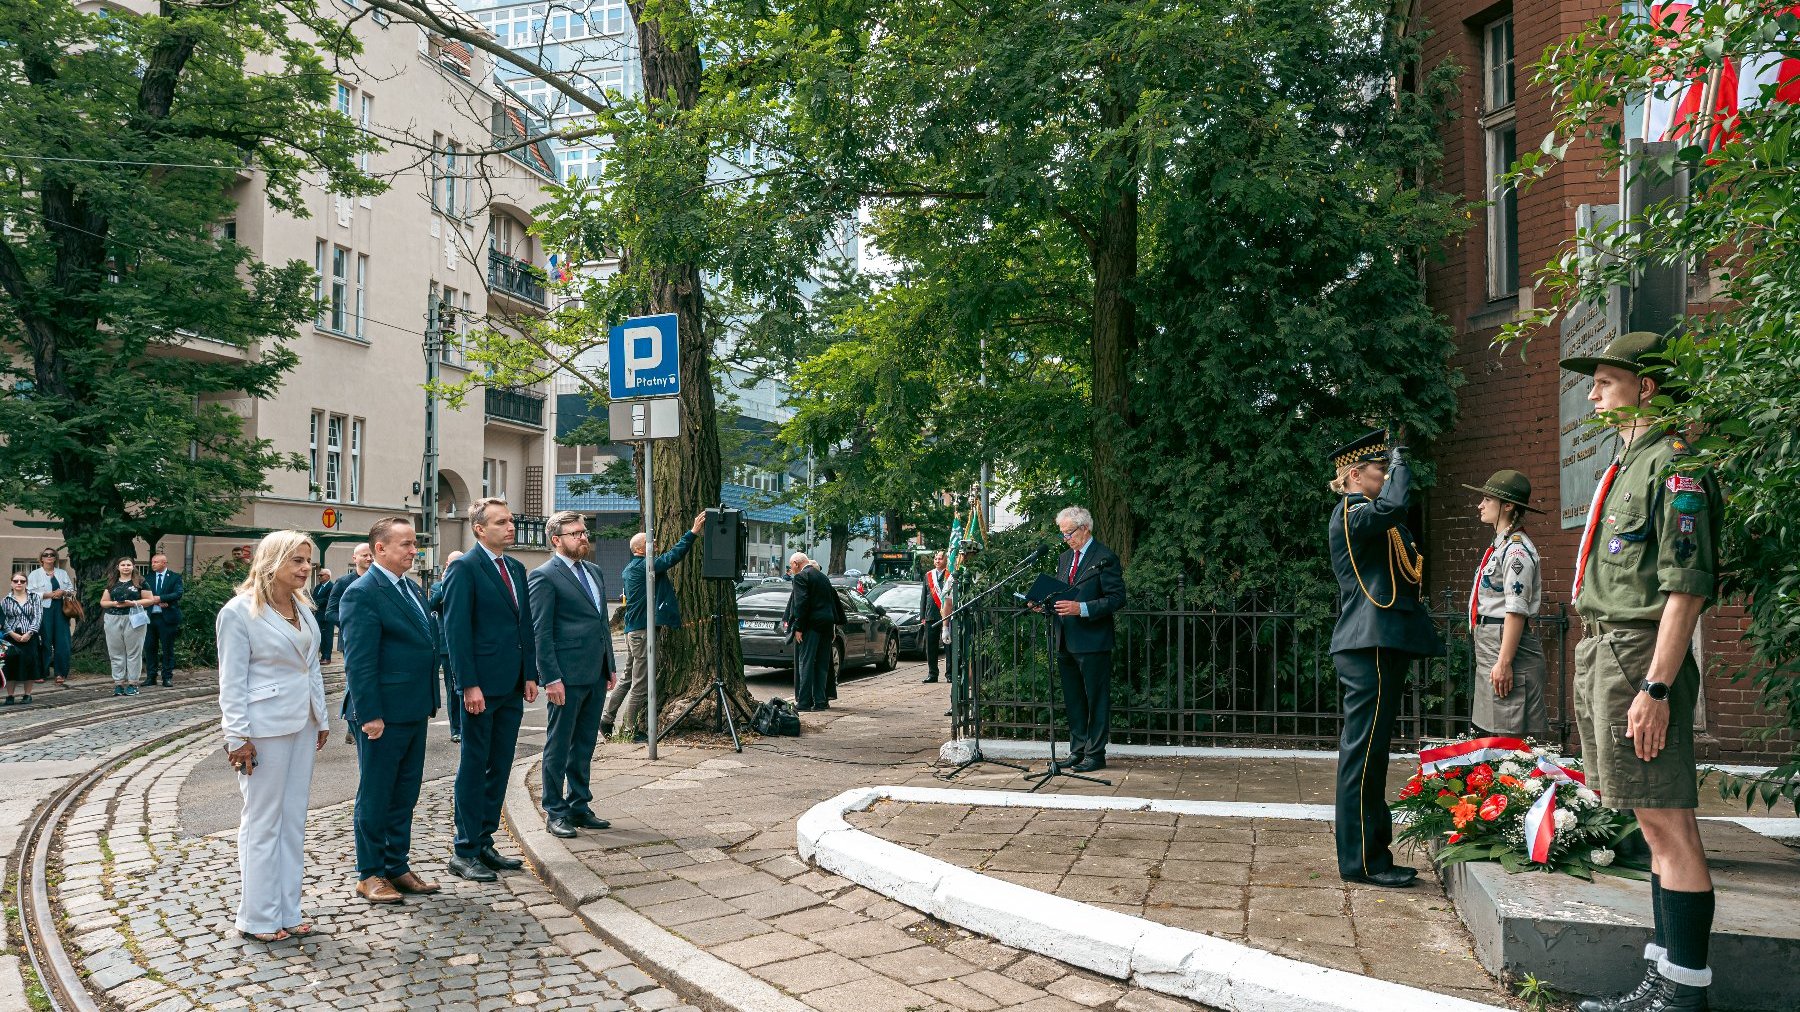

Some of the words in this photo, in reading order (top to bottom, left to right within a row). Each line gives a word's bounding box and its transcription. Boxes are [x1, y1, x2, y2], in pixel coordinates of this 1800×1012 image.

[623, 326, 662, 389] P
[636, 377, 668, 388] Płatny
[324, 511, 334, 528] T
